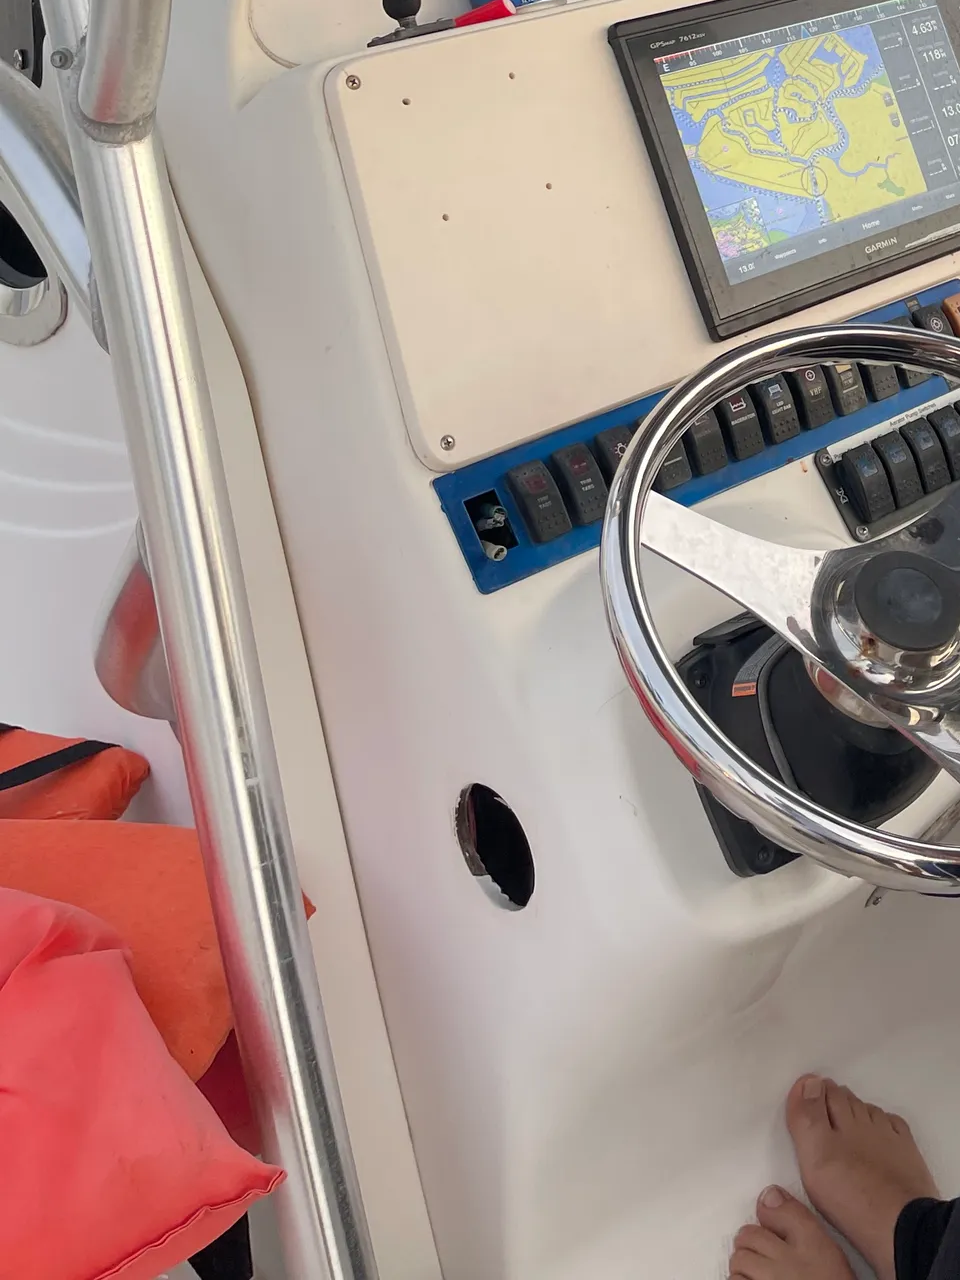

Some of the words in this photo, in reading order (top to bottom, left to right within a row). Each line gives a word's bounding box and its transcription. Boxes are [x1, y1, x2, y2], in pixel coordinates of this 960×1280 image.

[911, 22, 933, 37] 4.63
[922, 49, 941, 63] 118
[662, 63, 671, 73] E
[861, 218, 881, 230] Home
[863, 235, 898, 254] GARMIN
[808, 385, 823, 397] VHF
[888, 415, 906, 426] Aerator
[904, 409, 919, 420] Pump
[917, 401, 937, 414] Switches
